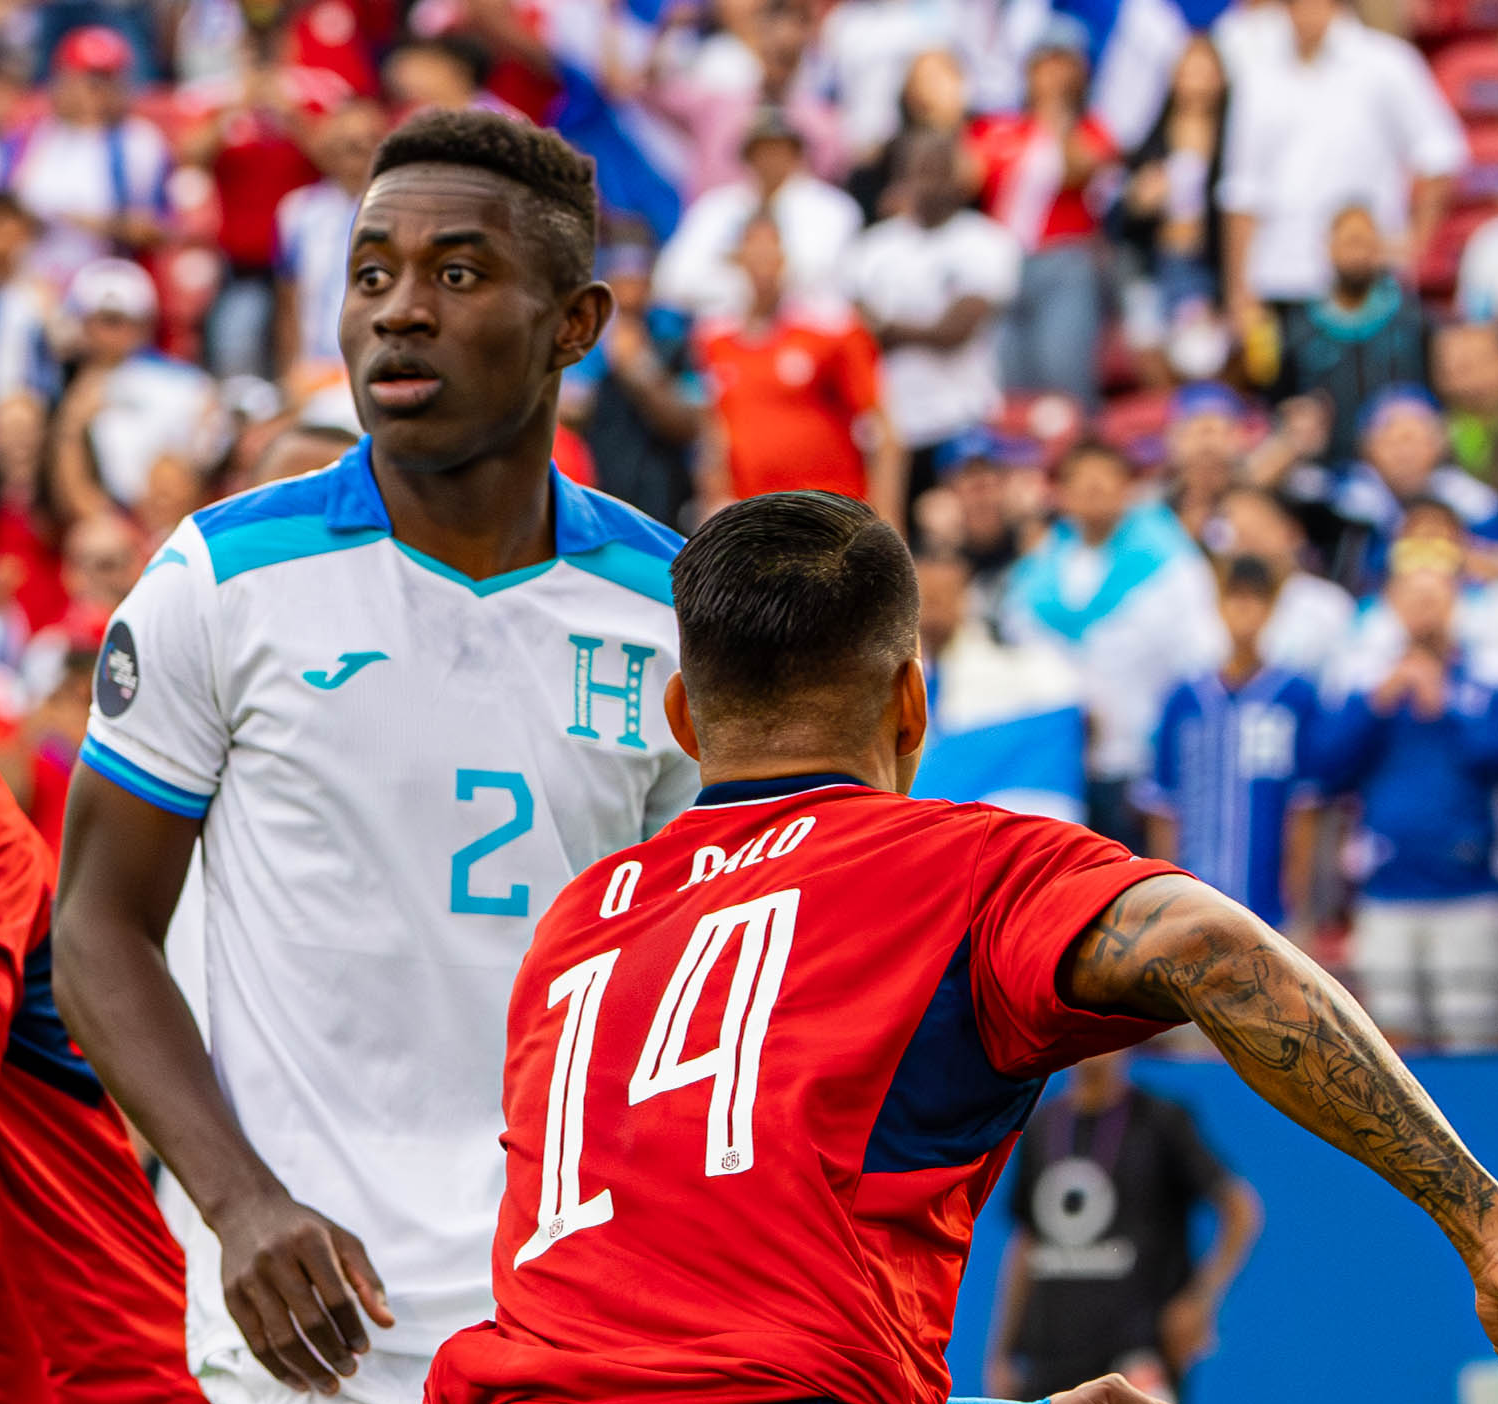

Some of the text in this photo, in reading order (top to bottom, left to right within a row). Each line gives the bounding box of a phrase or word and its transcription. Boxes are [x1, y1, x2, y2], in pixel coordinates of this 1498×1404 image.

[567, 633, 656, 750] H
[450, 768, 534, 917] 2
[513, 887, 801, 1271] 14
